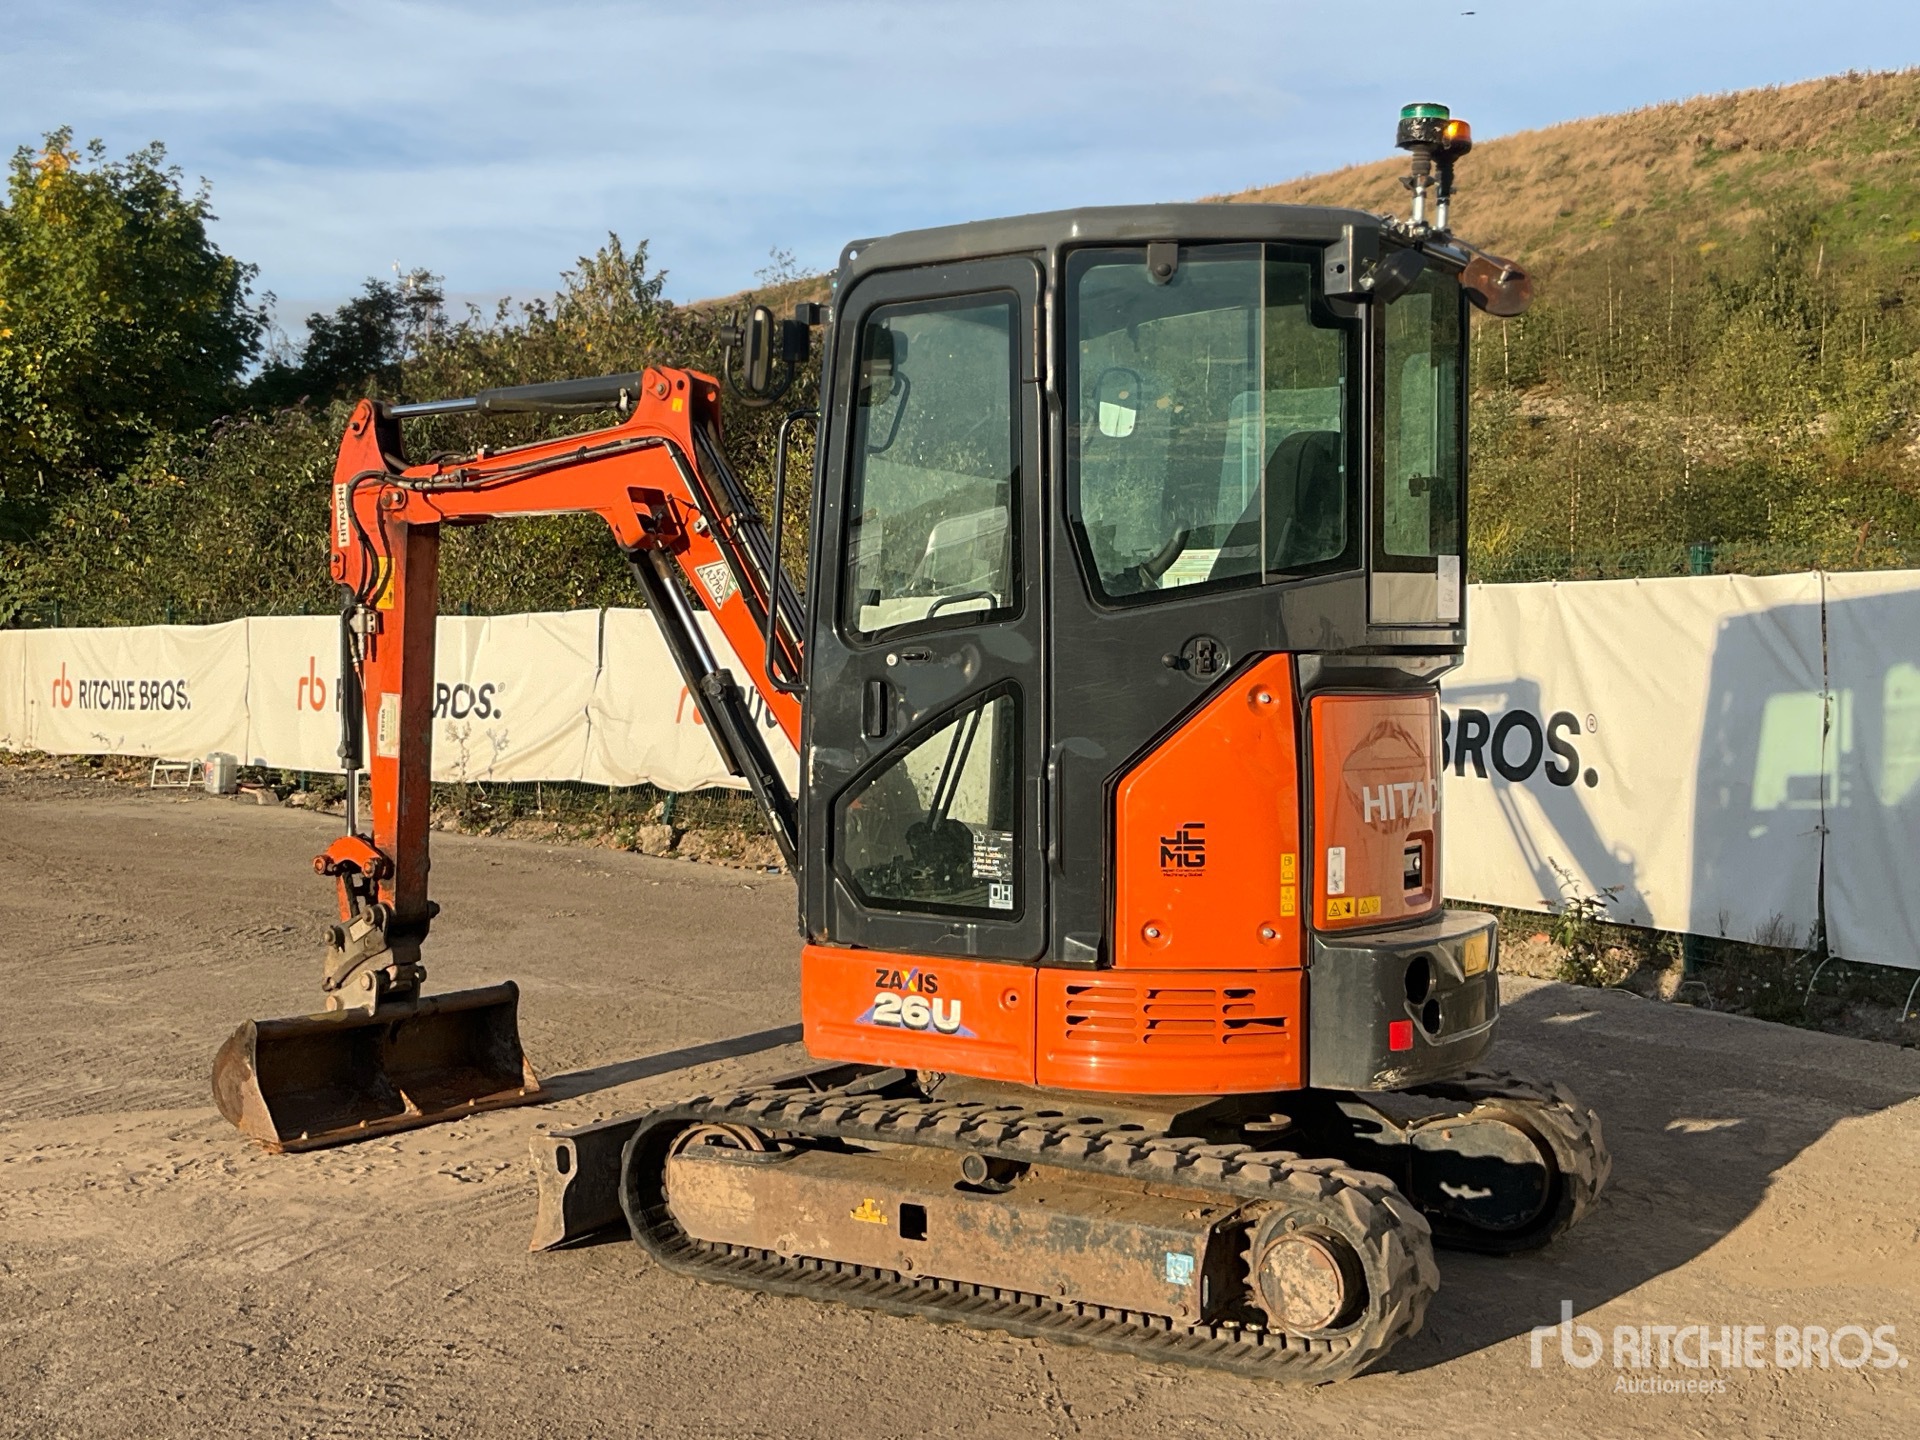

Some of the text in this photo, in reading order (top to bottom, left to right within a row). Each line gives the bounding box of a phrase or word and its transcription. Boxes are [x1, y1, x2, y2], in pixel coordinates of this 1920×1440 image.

[338, 487, 347, 543] HITACHI
[52, 662, 191, 710] rb RITCHIE BROS.
[297, 656, 327, 712] rb
[432, 682, 502, 719] ROS.
[875, 967, 938, 994] ZAXIS
[873, 991, 961, 1034] 26U
